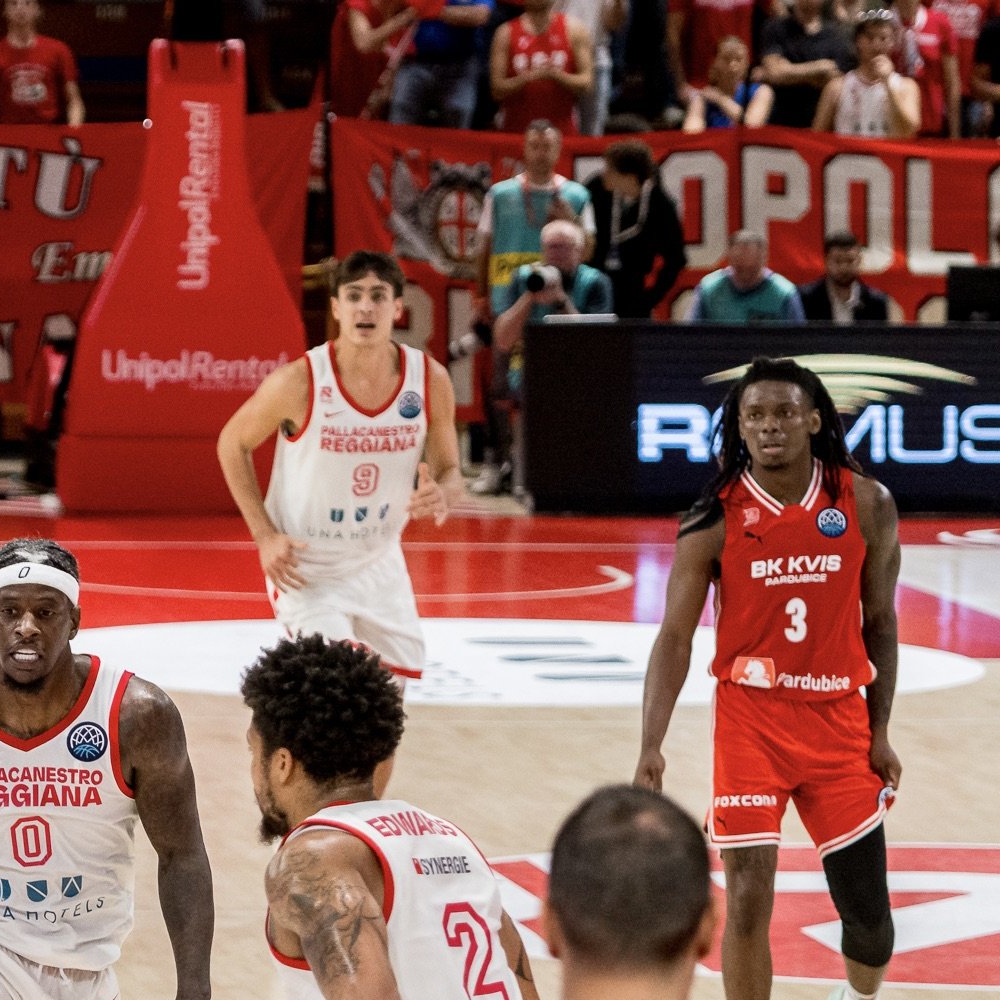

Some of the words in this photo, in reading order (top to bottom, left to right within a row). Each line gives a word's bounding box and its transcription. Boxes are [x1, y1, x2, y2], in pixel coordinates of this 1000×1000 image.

[320, 437, 417, 453] REGGIANA
[352, 463, 380, 497] 9
[751, 558, 783, 579] BK
[788, 554, 842, 574] KVIS
[783, 597, 808, 643] 3
[10, 815, 53, 868] 0
[421, 856, 471, 876] SYNERGIE
[26, 896, 106, 924] HOTELS
